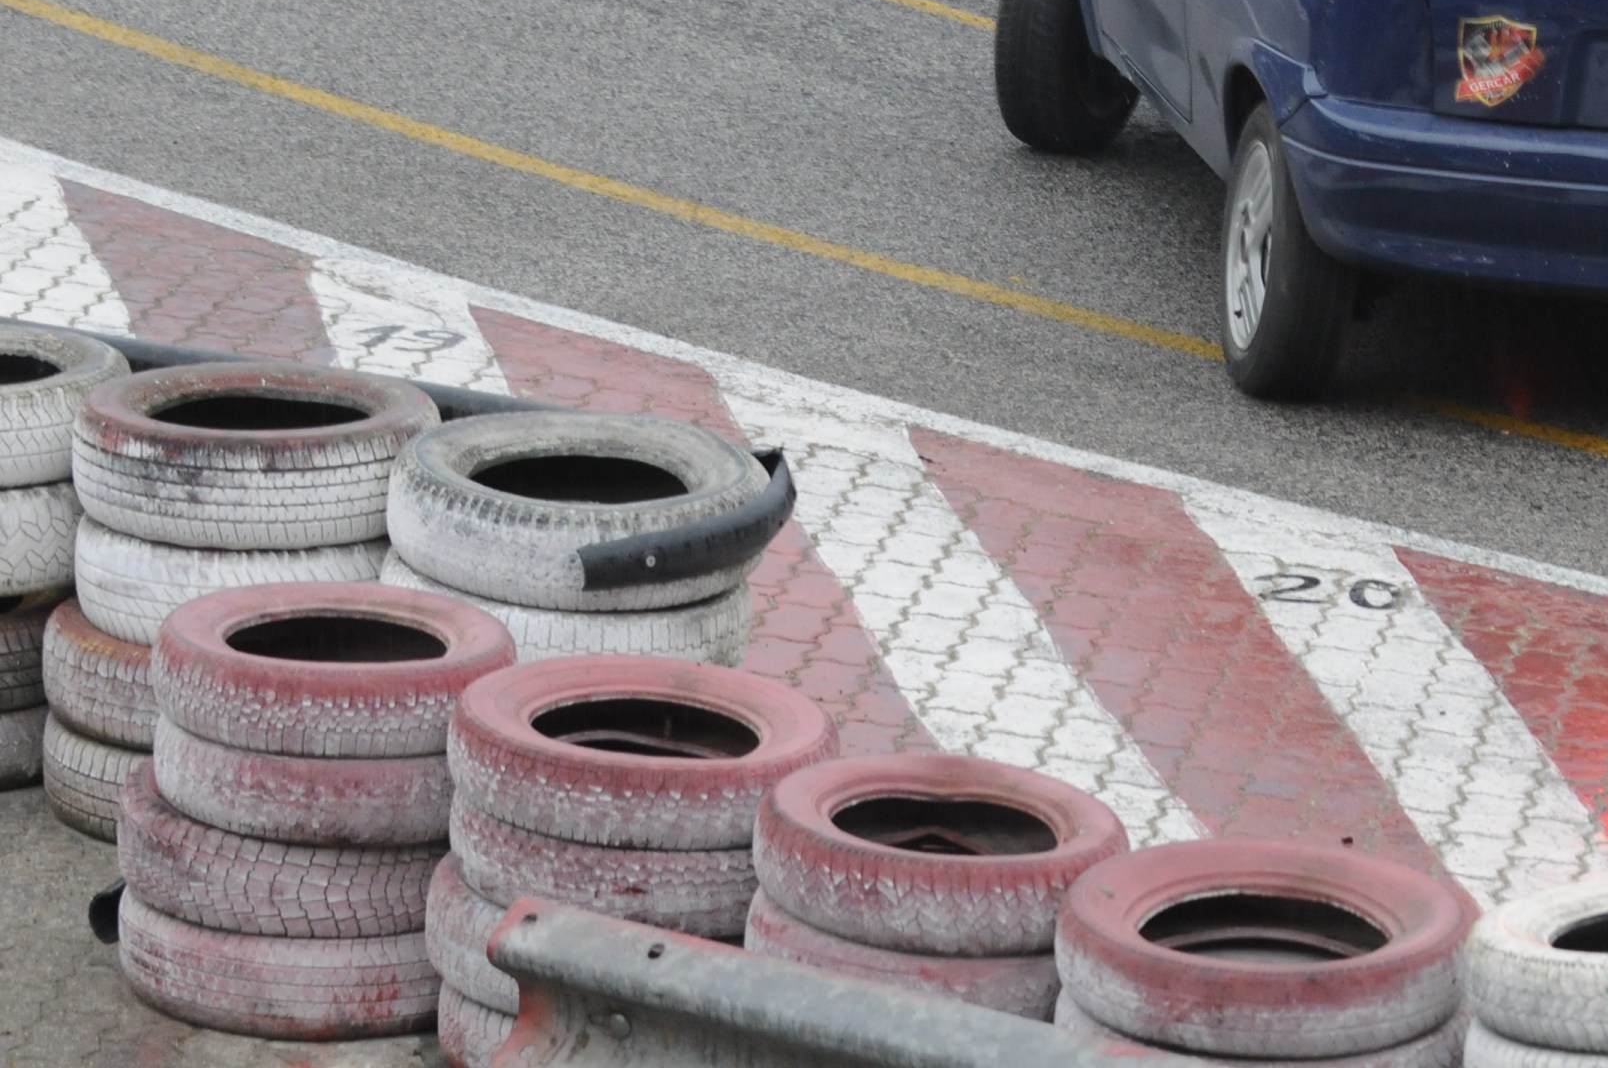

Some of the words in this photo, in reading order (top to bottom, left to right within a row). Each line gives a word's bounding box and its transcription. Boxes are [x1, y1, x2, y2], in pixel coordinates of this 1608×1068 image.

[1468, 71, 1522, 93] GERCAR
[353, 325, 467, 352] 19
[1253, 573, 1401, 610] 20
